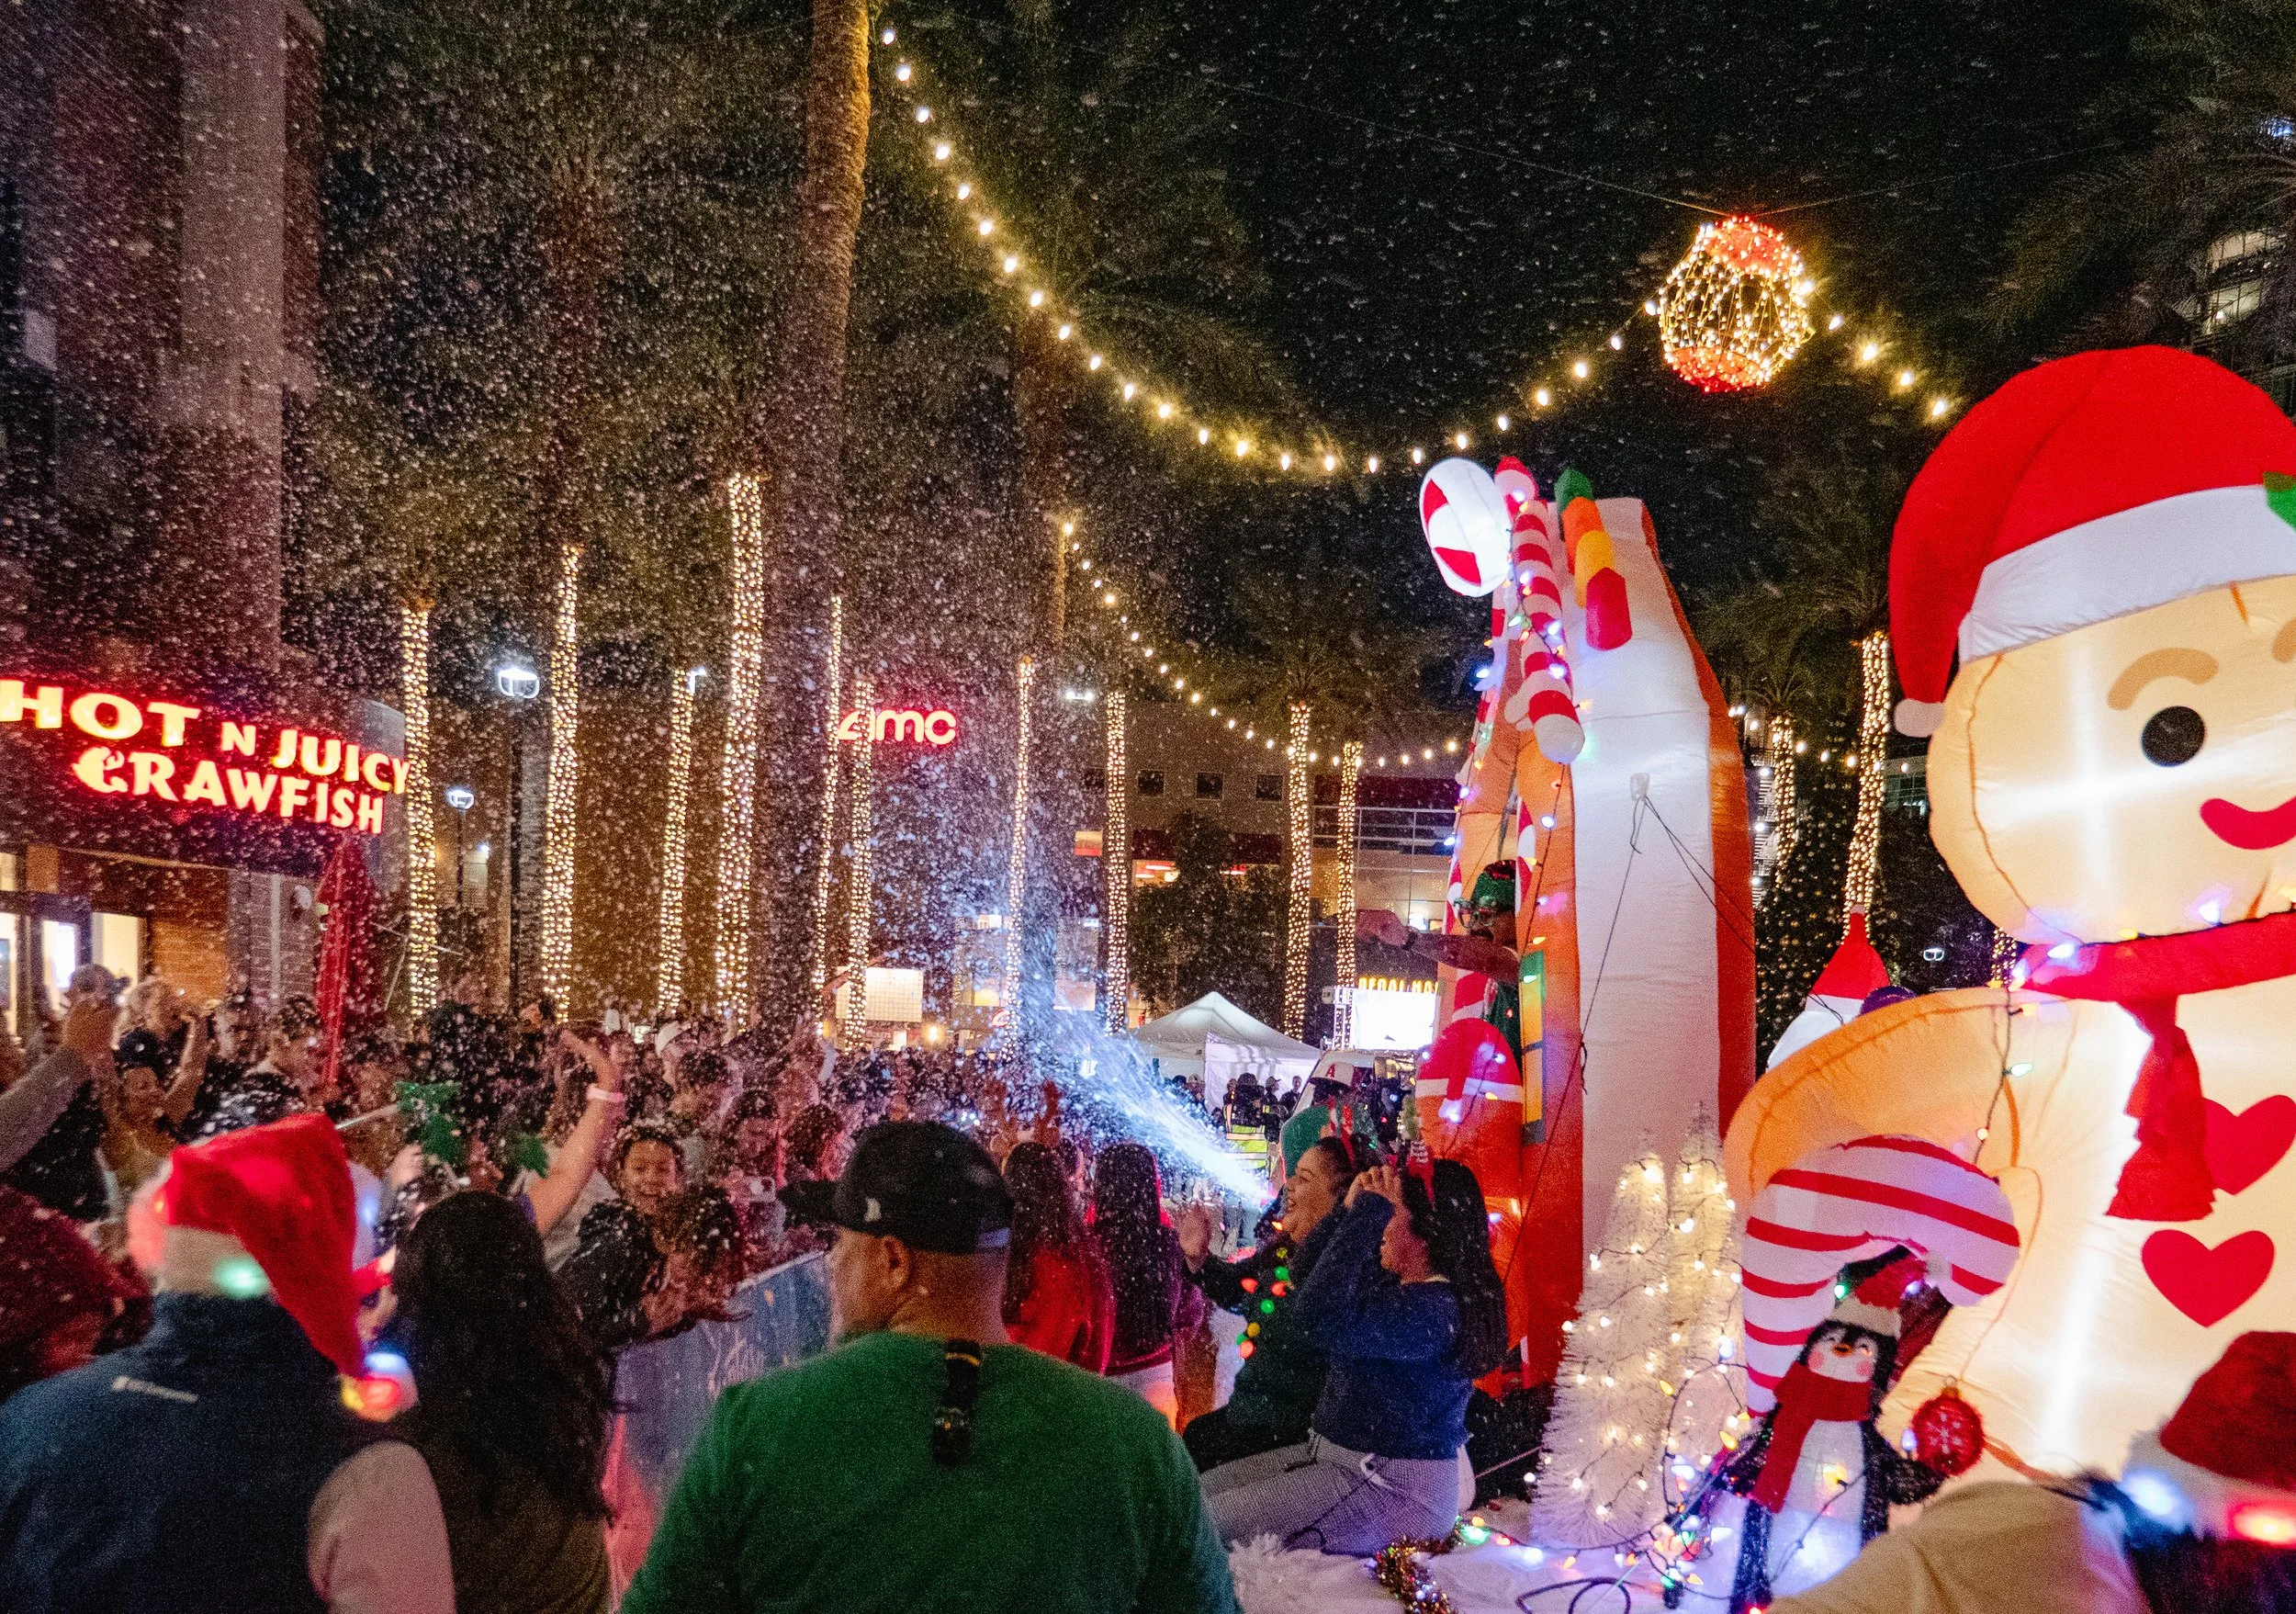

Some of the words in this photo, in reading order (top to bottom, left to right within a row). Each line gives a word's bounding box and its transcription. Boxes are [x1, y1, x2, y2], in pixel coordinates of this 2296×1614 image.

[0, 680, 200, 747] HOT
[220, 722, 256, 756] N
[272, 729, 410, 796] JUICY
[73, 746, 384, 834] CRAWFISH
[1325, 1063, 1335, 1078] A
